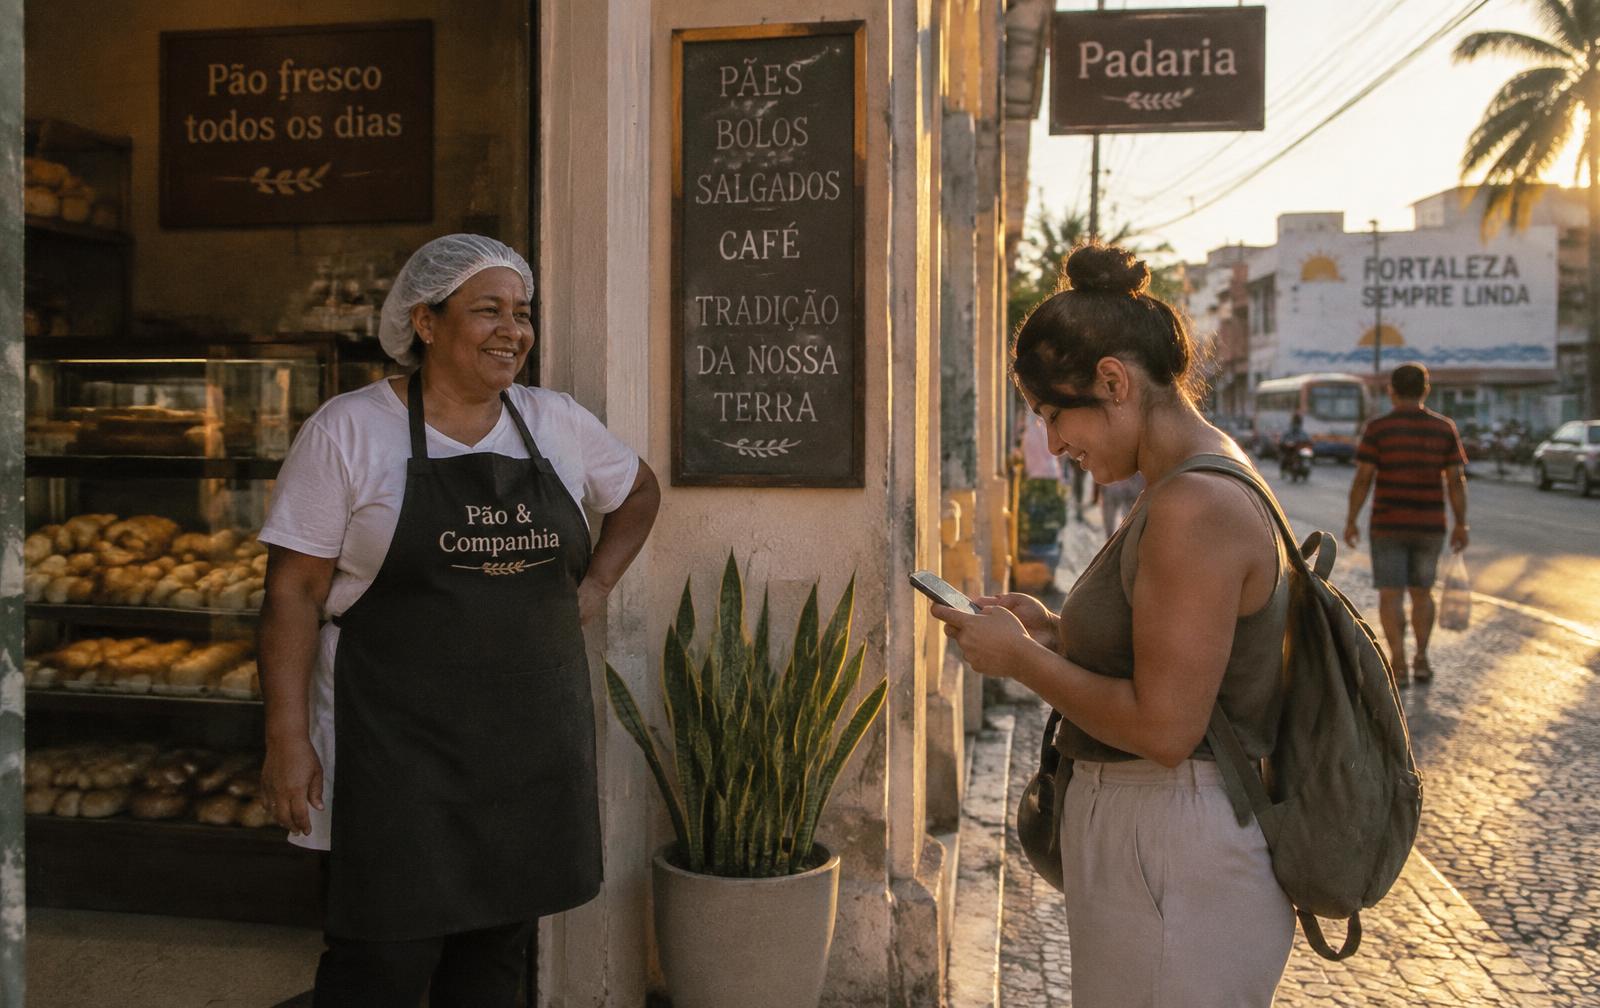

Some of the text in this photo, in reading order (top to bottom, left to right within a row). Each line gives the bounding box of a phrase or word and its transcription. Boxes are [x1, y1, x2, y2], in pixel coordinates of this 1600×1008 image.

[1078, 38, 1237, 79] Padaria
[207, 58, 382, 100] Pão fresco
[720, 57, 803, 97] PÃES
[185, 106, 402, 143] todos os dias
[716, 116, 808, 150] BOLOS
[696, 170, 840, 204] SALGADOS
[720, 221, 800, 260] CAFÉ
[1364, 255, 1519, 281] FORTALEZA
[696, 289, 839, 331] TRADIÇÃO
[1362, 284, 1530, 307] SEMPRE LINDA
[697, 345, 839, 375] DA NOSSA
[714, 392, 818, 422] TERRA
[465, 503, 532, 525] Pão &
[439, 528, 560, 557] Companhia
